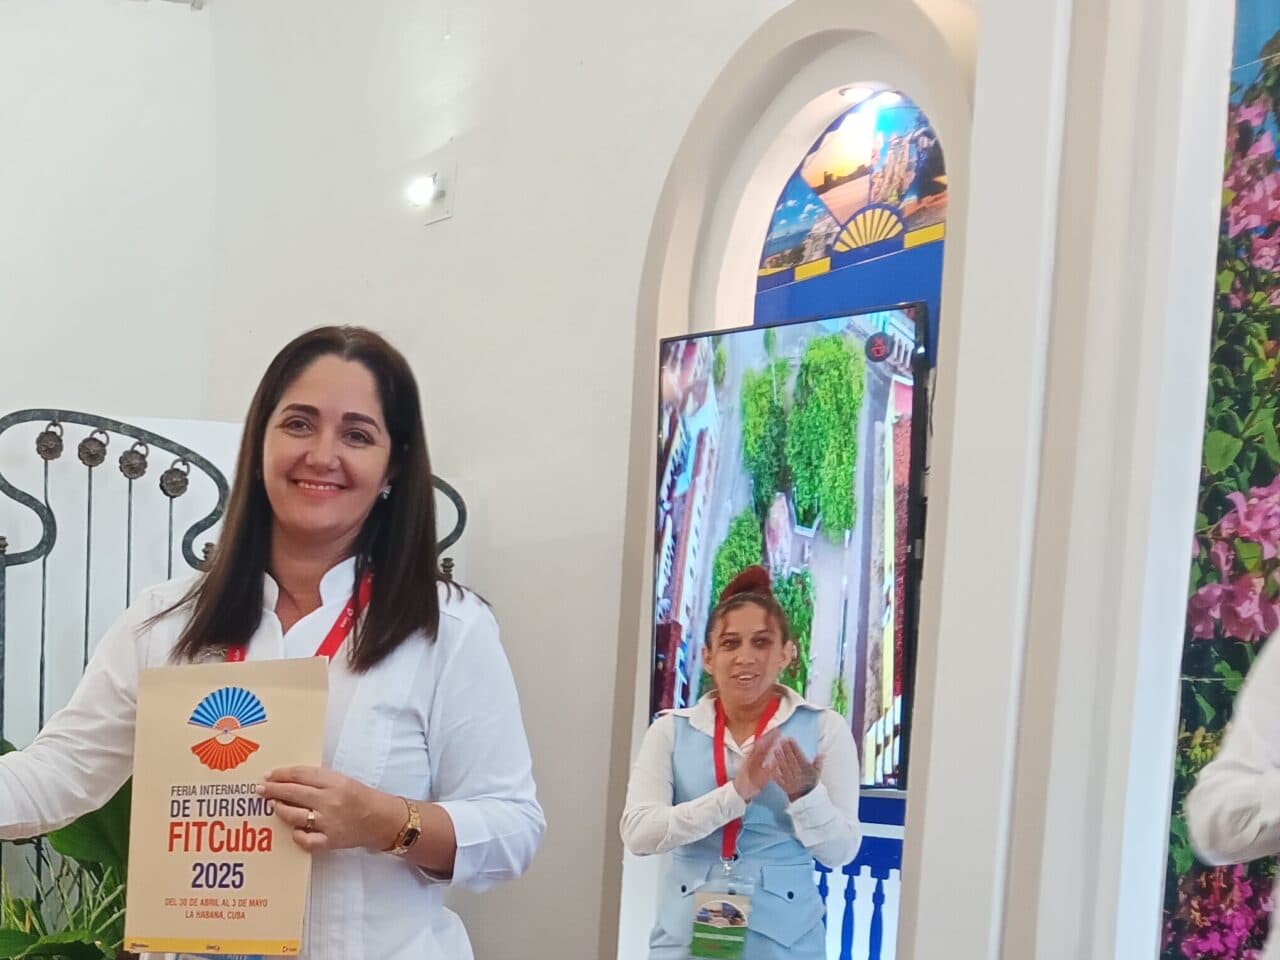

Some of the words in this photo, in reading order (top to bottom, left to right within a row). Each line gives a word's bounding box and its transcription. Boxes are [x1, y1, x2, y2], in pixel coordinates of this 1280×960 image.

[171, 785, 197, 796] FERIA
[200, 783, 261, 795] INTERNACIO
[171, 799, 191, 818] DE
[197, 797, 275, 817] TURISMO
[168, 821, 273, 853] FITCuba
[191, 862, 244, 889] 2025
[165, 898, 177, 906] DEL
[189, 898, 198, 906] DE
[200, 899, 219, 907] ABRIL
[222, 899, 229, 907] AL
[238, 899, 247, 907] DE
[249, 899, 268, 907] MAYO
[185, 910, 194, 919] LA
[227, 911, 245, 920] CUBA
